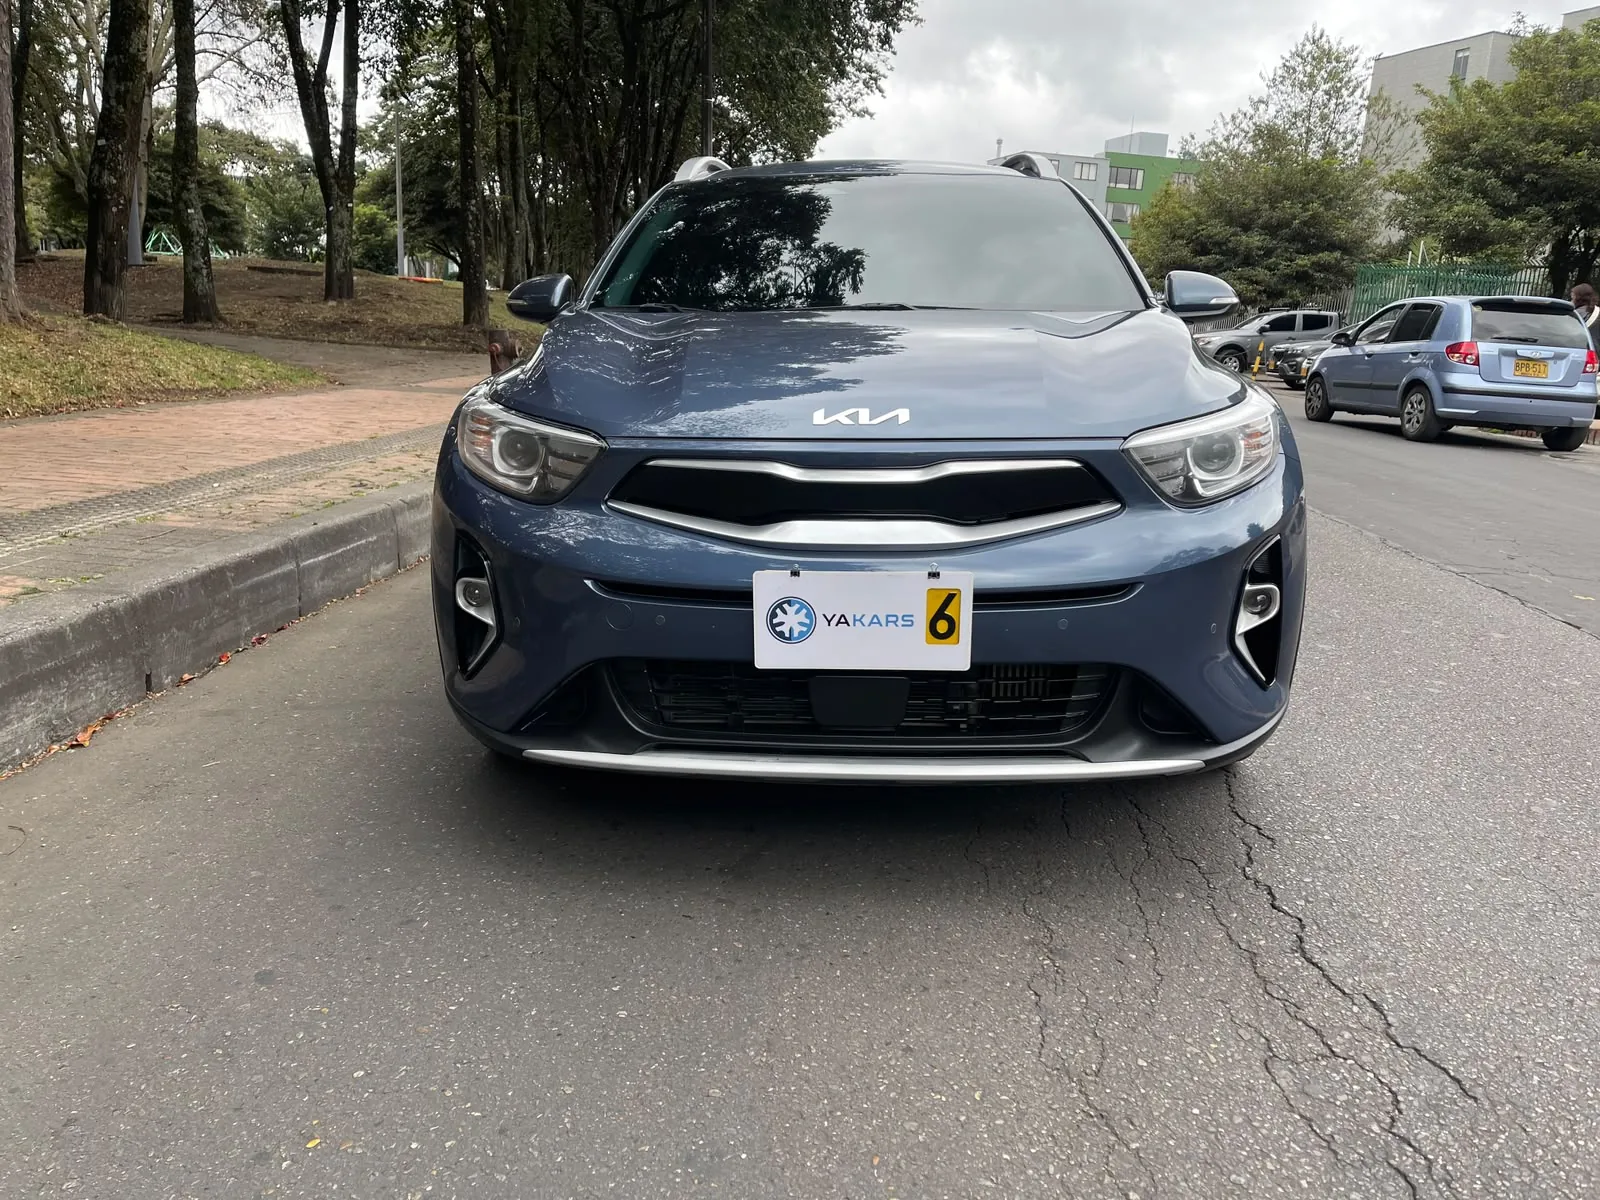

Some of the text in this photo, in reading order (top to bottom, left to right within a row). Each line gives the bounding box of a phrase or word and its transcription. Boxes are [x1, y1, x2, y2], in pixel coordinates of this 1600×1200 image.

[812, 407, 910, 425] KIA
[823, 613, 914, 627] YAKARS
[929, 592, 958, 640] 6
